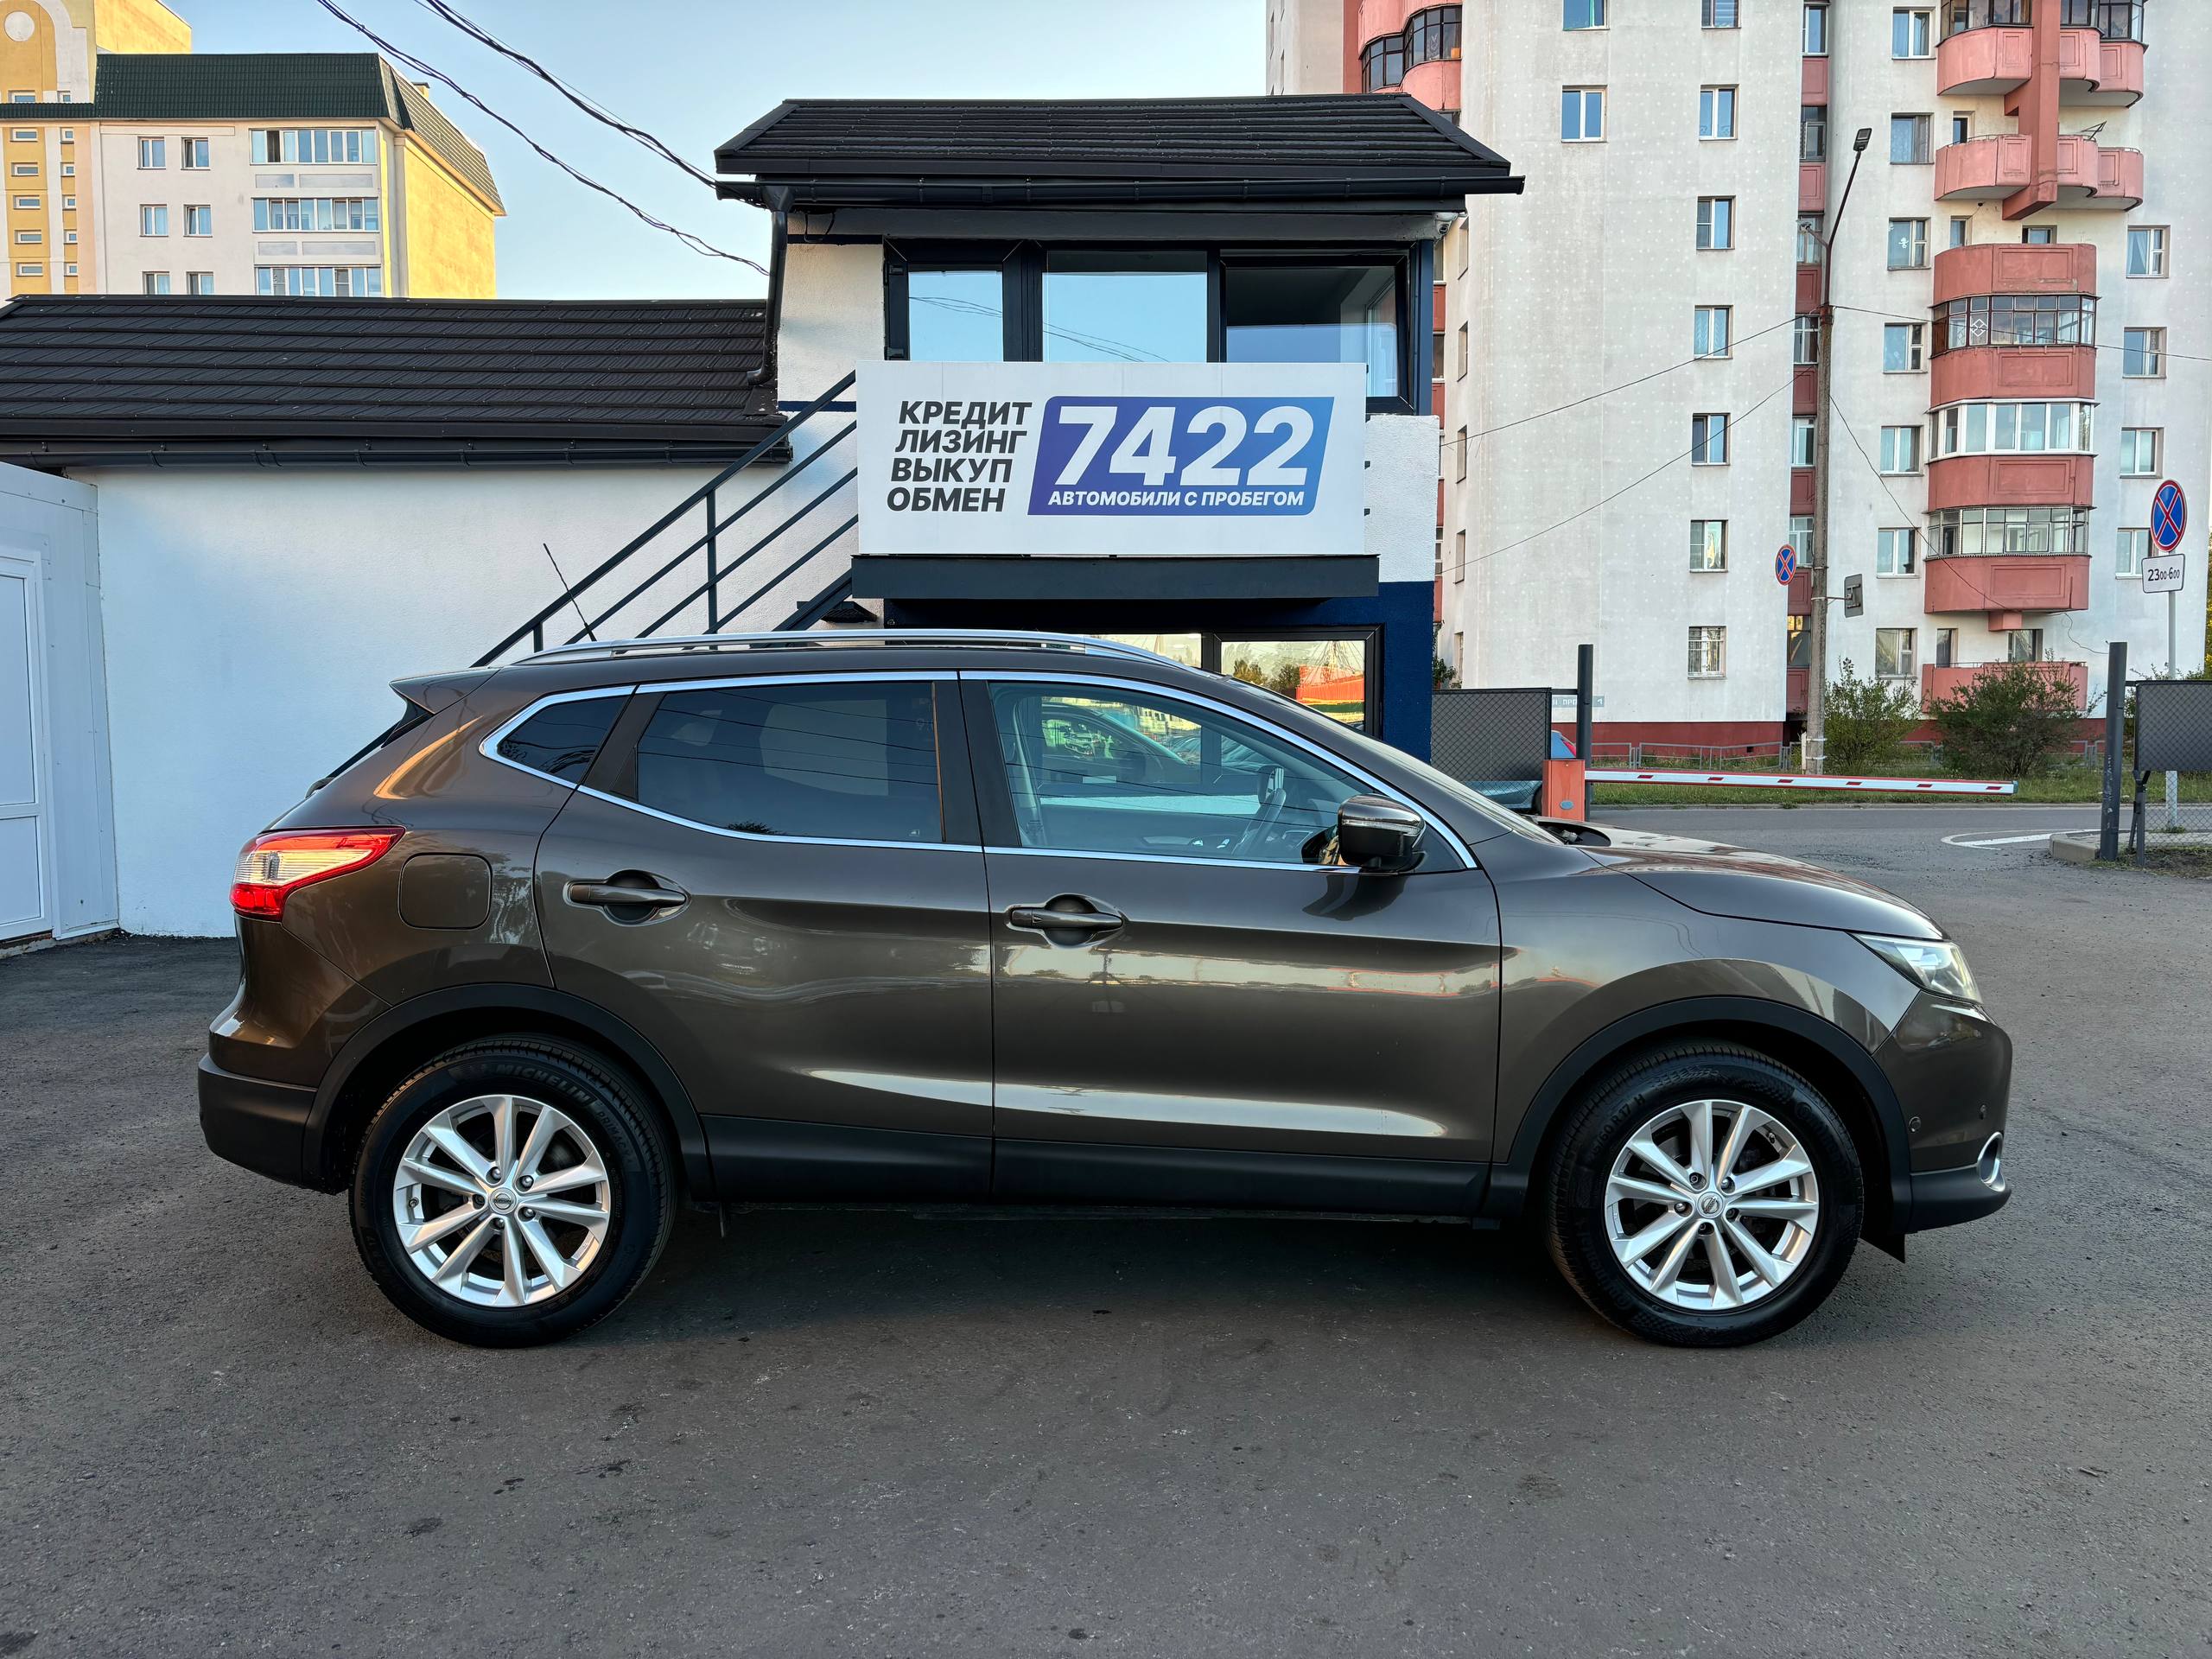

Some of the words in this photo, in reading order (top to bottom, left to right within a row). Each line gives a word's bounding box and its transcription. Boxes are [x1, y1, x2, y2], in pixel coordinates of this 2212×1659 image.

[898, 400, 1033, 430] КРЕДИТ
[894, 429, 1028, 454] ЛИЗИНГ
[1053, 404, 1314, 486] 7422
[890, 457, 1014, 483] ВЫКУП
[887, 486, 1007, 512] ОБМЕН
[1047, 490, 1181, 506] АВТОМОБИЛИ
[1183, 490, 1198, 506] С
[1200, 490, 1305, 506] ПРОБЕГОМ
[498, 1064, 594, 1105] MICHELIN
